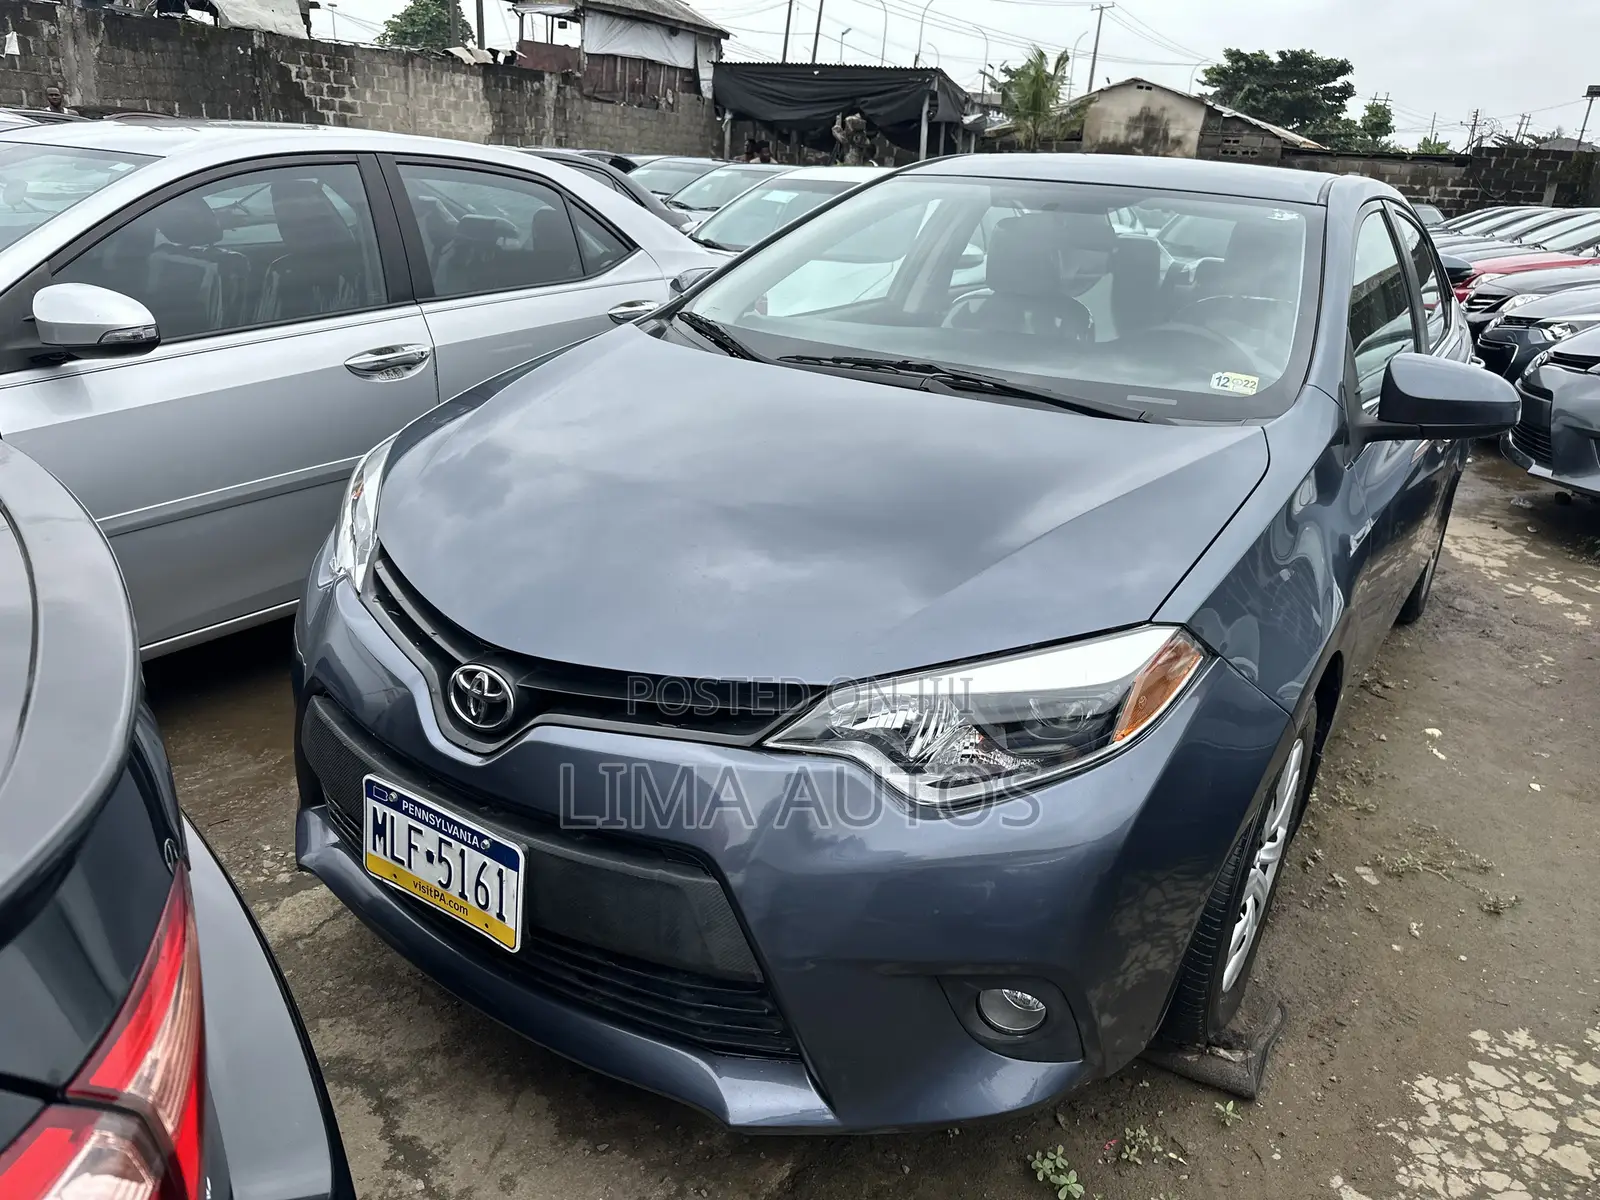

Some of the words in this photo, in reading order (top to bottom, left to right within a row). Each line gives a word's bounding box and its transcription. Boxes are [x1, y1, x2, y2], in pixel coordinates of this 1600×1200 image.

[1215, 376, 1230, 388] 12
[1243, 379, 1257, 390] 22
[402, 799, 480, 849] PENNSYLVANIA
[412, 879, 469, 916] visitPA.com
